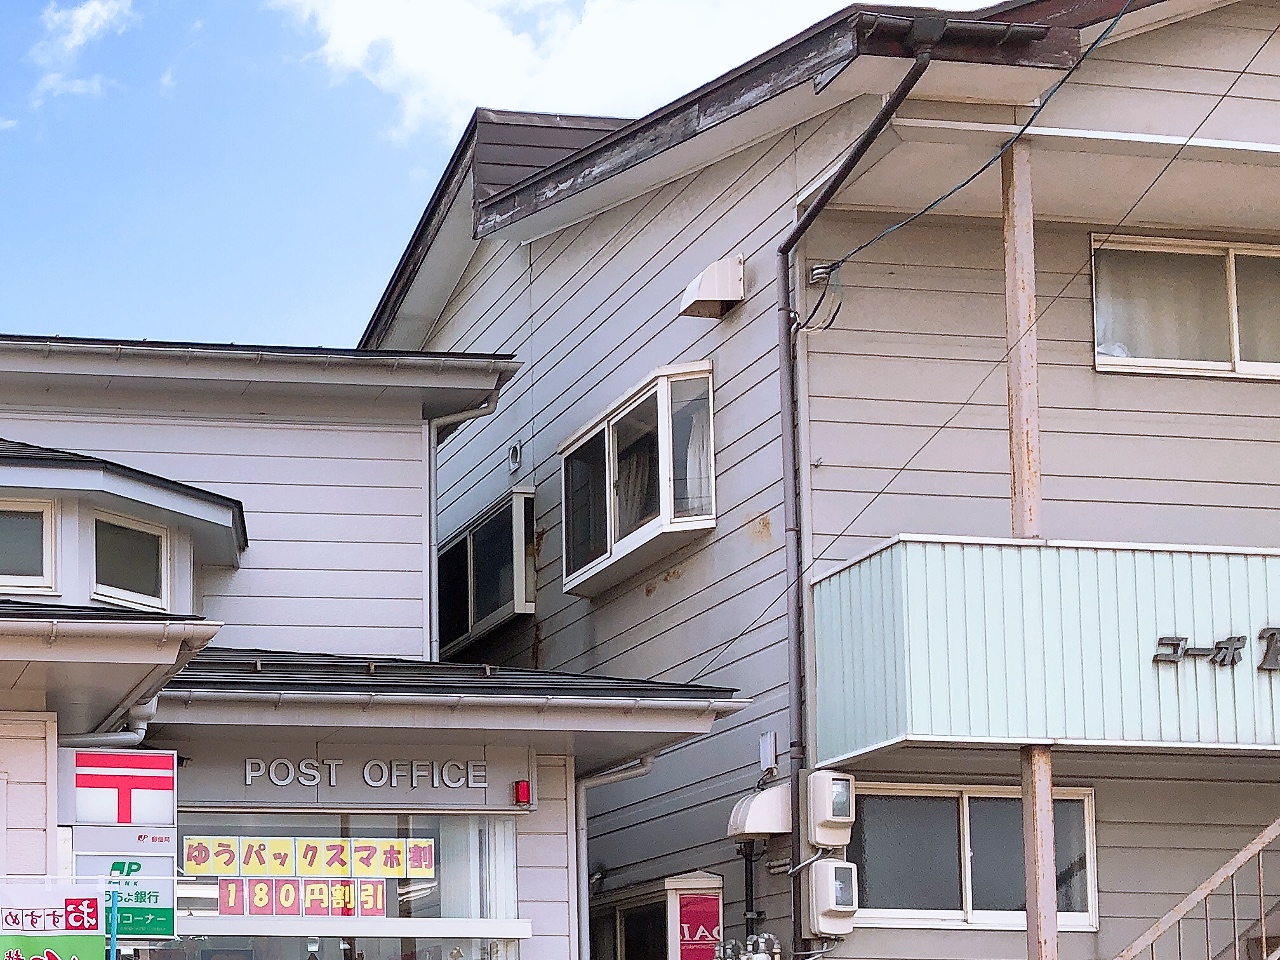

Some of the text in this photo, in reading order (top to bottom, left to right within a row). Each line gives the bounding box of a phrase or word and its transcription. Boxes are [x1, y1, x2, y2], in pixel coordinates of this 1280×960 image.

[1152, 635, 1248, 667] コーポ
[244, 758, 489, 788] POST OFFICE
[137, 834, 149, 842] JP
[186, 842, 434, 870] ゆうパックスマホ割
[105, 890, 160, 904] うちょ銀行
[226, 881, 384, 910] 180円割引
